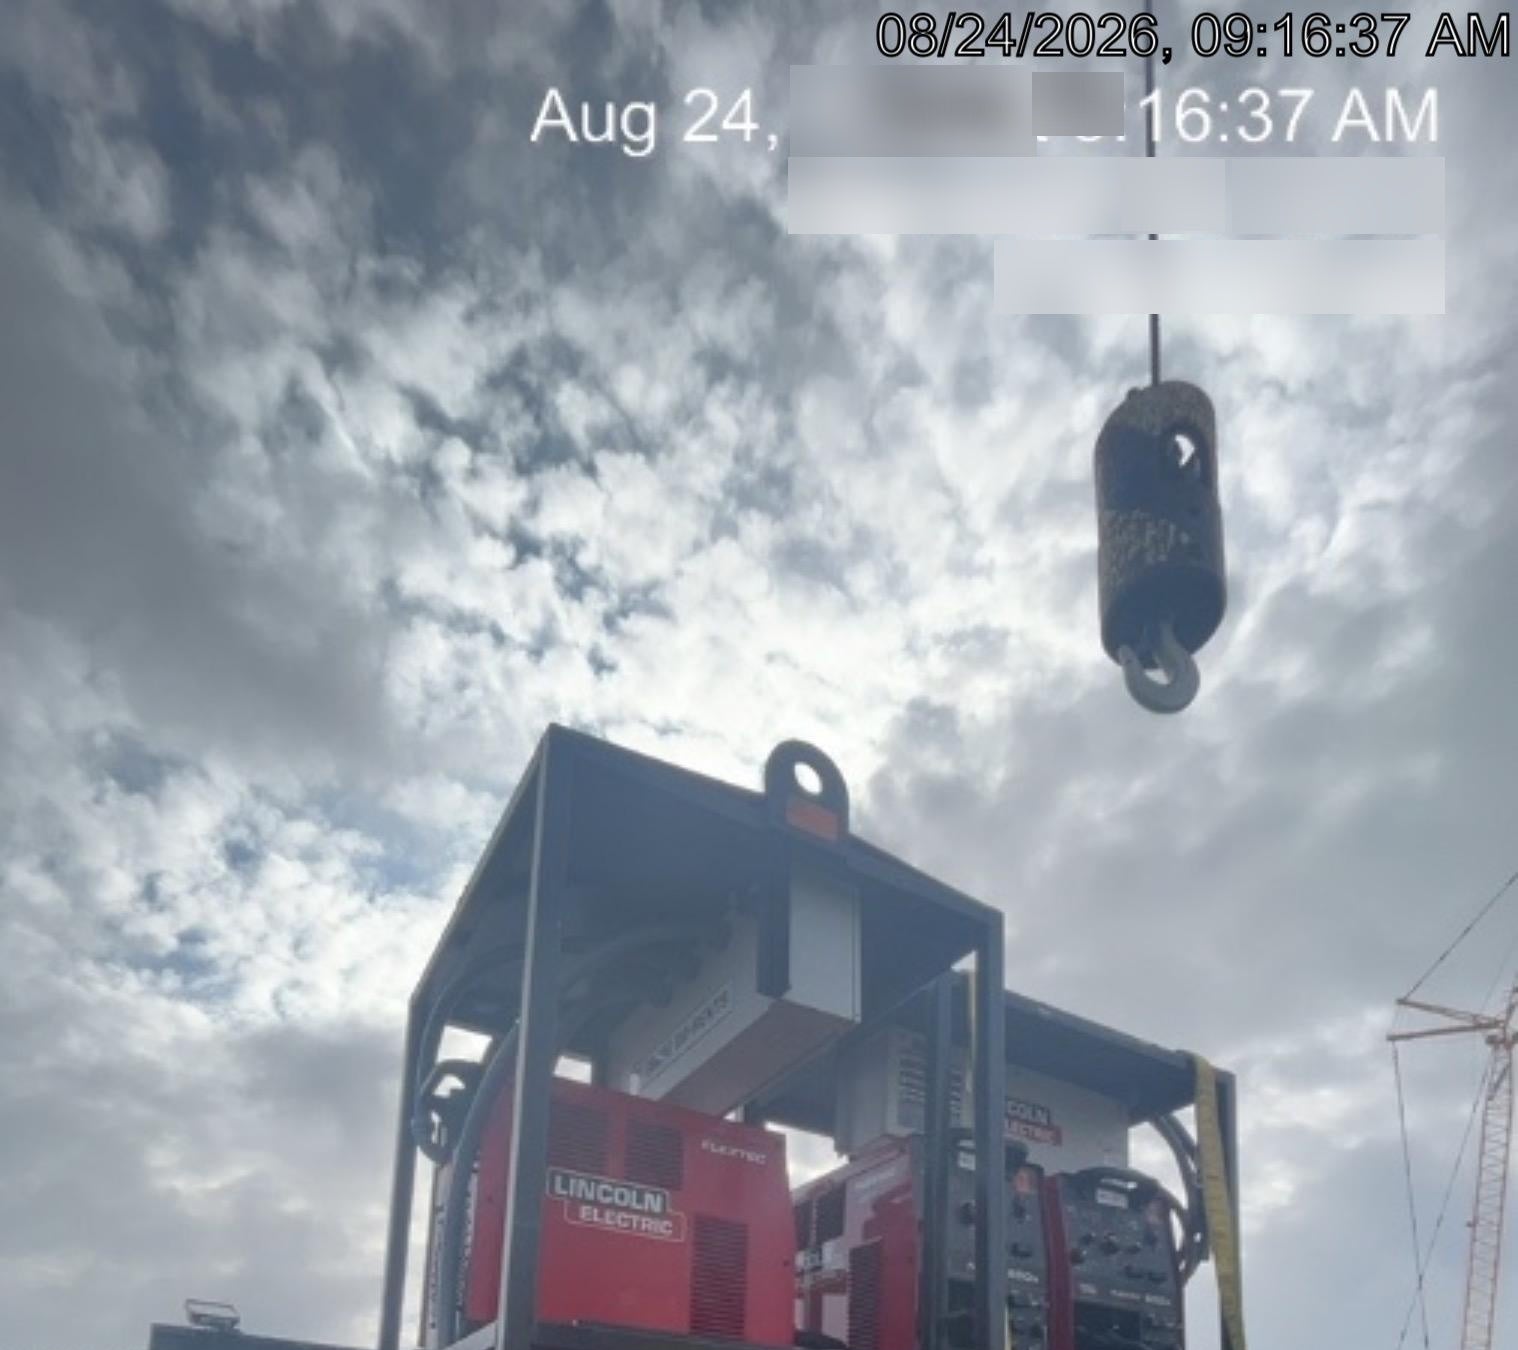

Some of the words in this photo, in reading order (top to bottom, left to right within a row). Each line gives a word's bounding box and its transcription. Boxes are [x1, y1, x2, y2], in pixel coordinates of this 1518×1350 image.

[702, 1139, 766, 1165] FLEXTEC
[554, 1175, 663, 1214] LINCOLN
[579, 1205, 673, 1235] ELECTRIC
